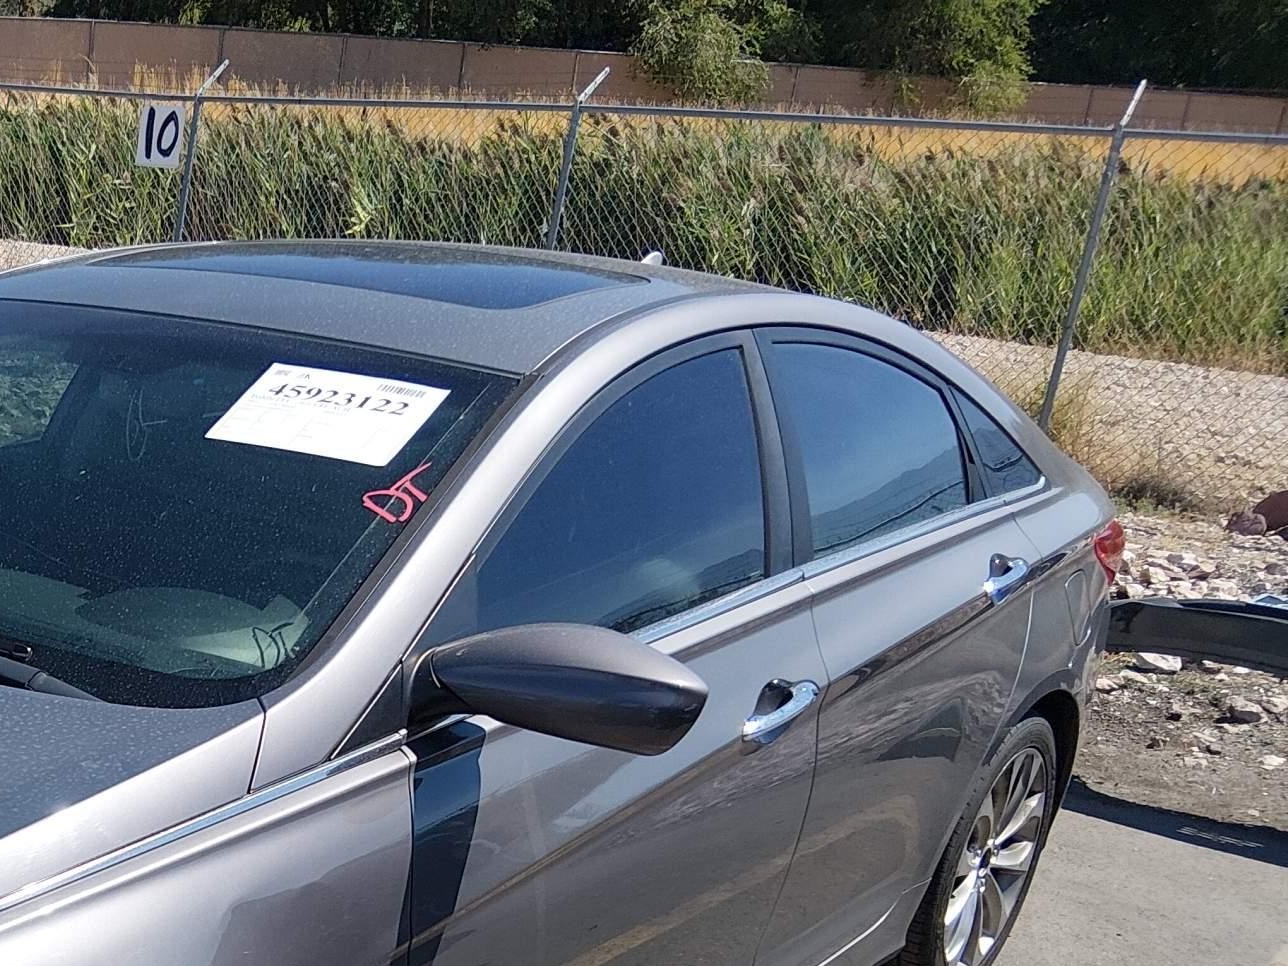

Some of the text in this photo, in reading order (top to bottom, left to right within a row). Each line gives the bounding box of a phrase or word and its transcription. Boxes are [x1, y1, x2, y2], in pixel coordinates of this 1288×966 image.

[145, 106, 179, 159] 10
[269, 383, 410, 416] 45923122
[362, 461, 433, 524] DT
